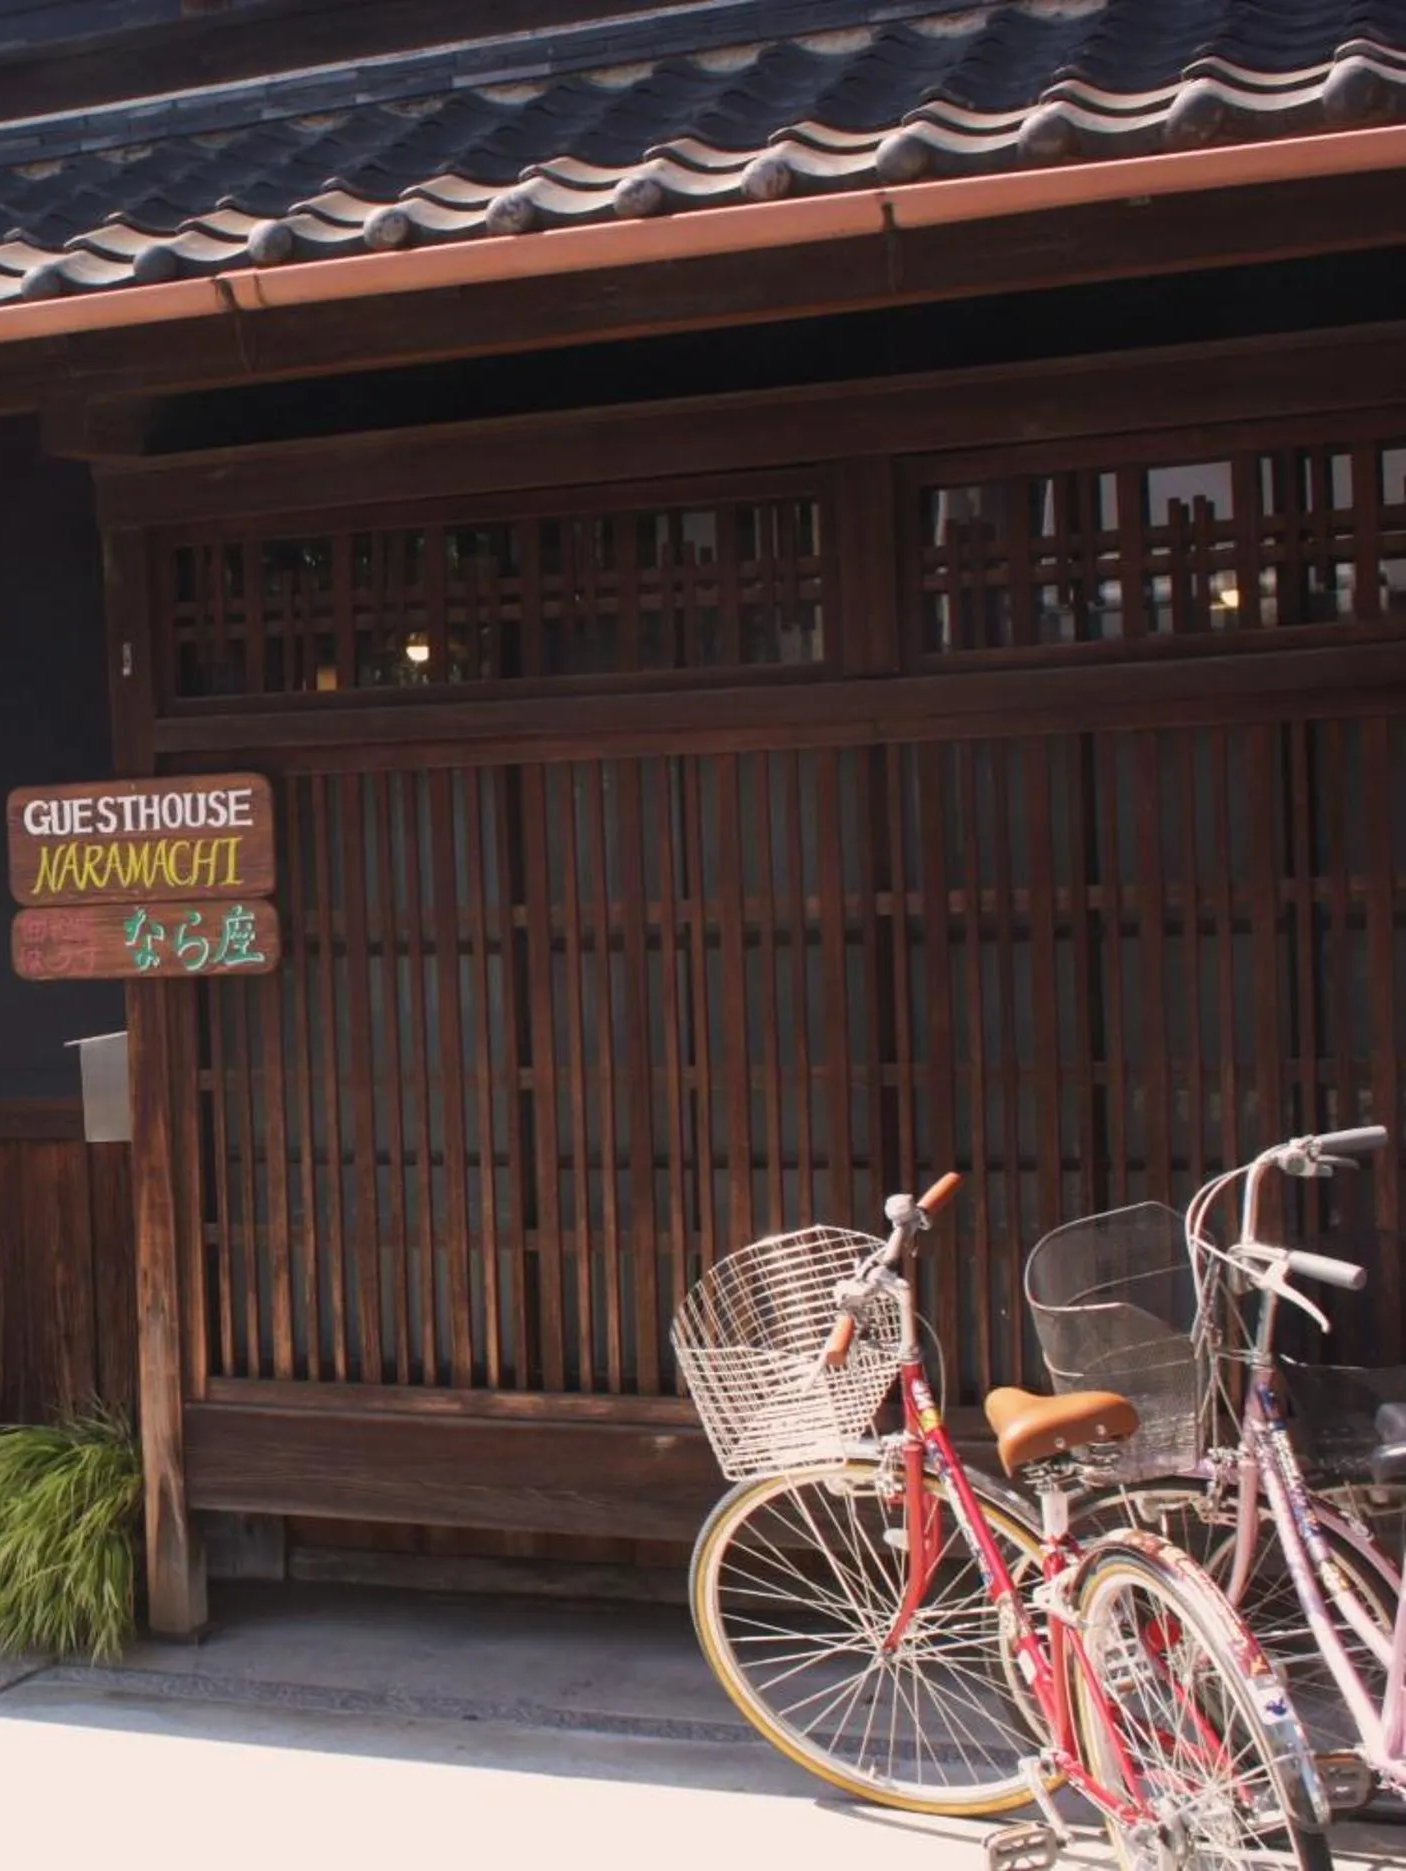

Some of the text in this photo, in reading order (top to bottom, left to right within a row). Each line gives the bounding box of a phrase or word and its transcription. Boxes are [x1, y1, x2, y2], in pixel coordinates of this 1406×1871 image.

[23, 788, 254, 836] GUESTHOUSE
[31, 836, 244, 895] NARAMACHI
[123, 904, 266, 973] なら座
